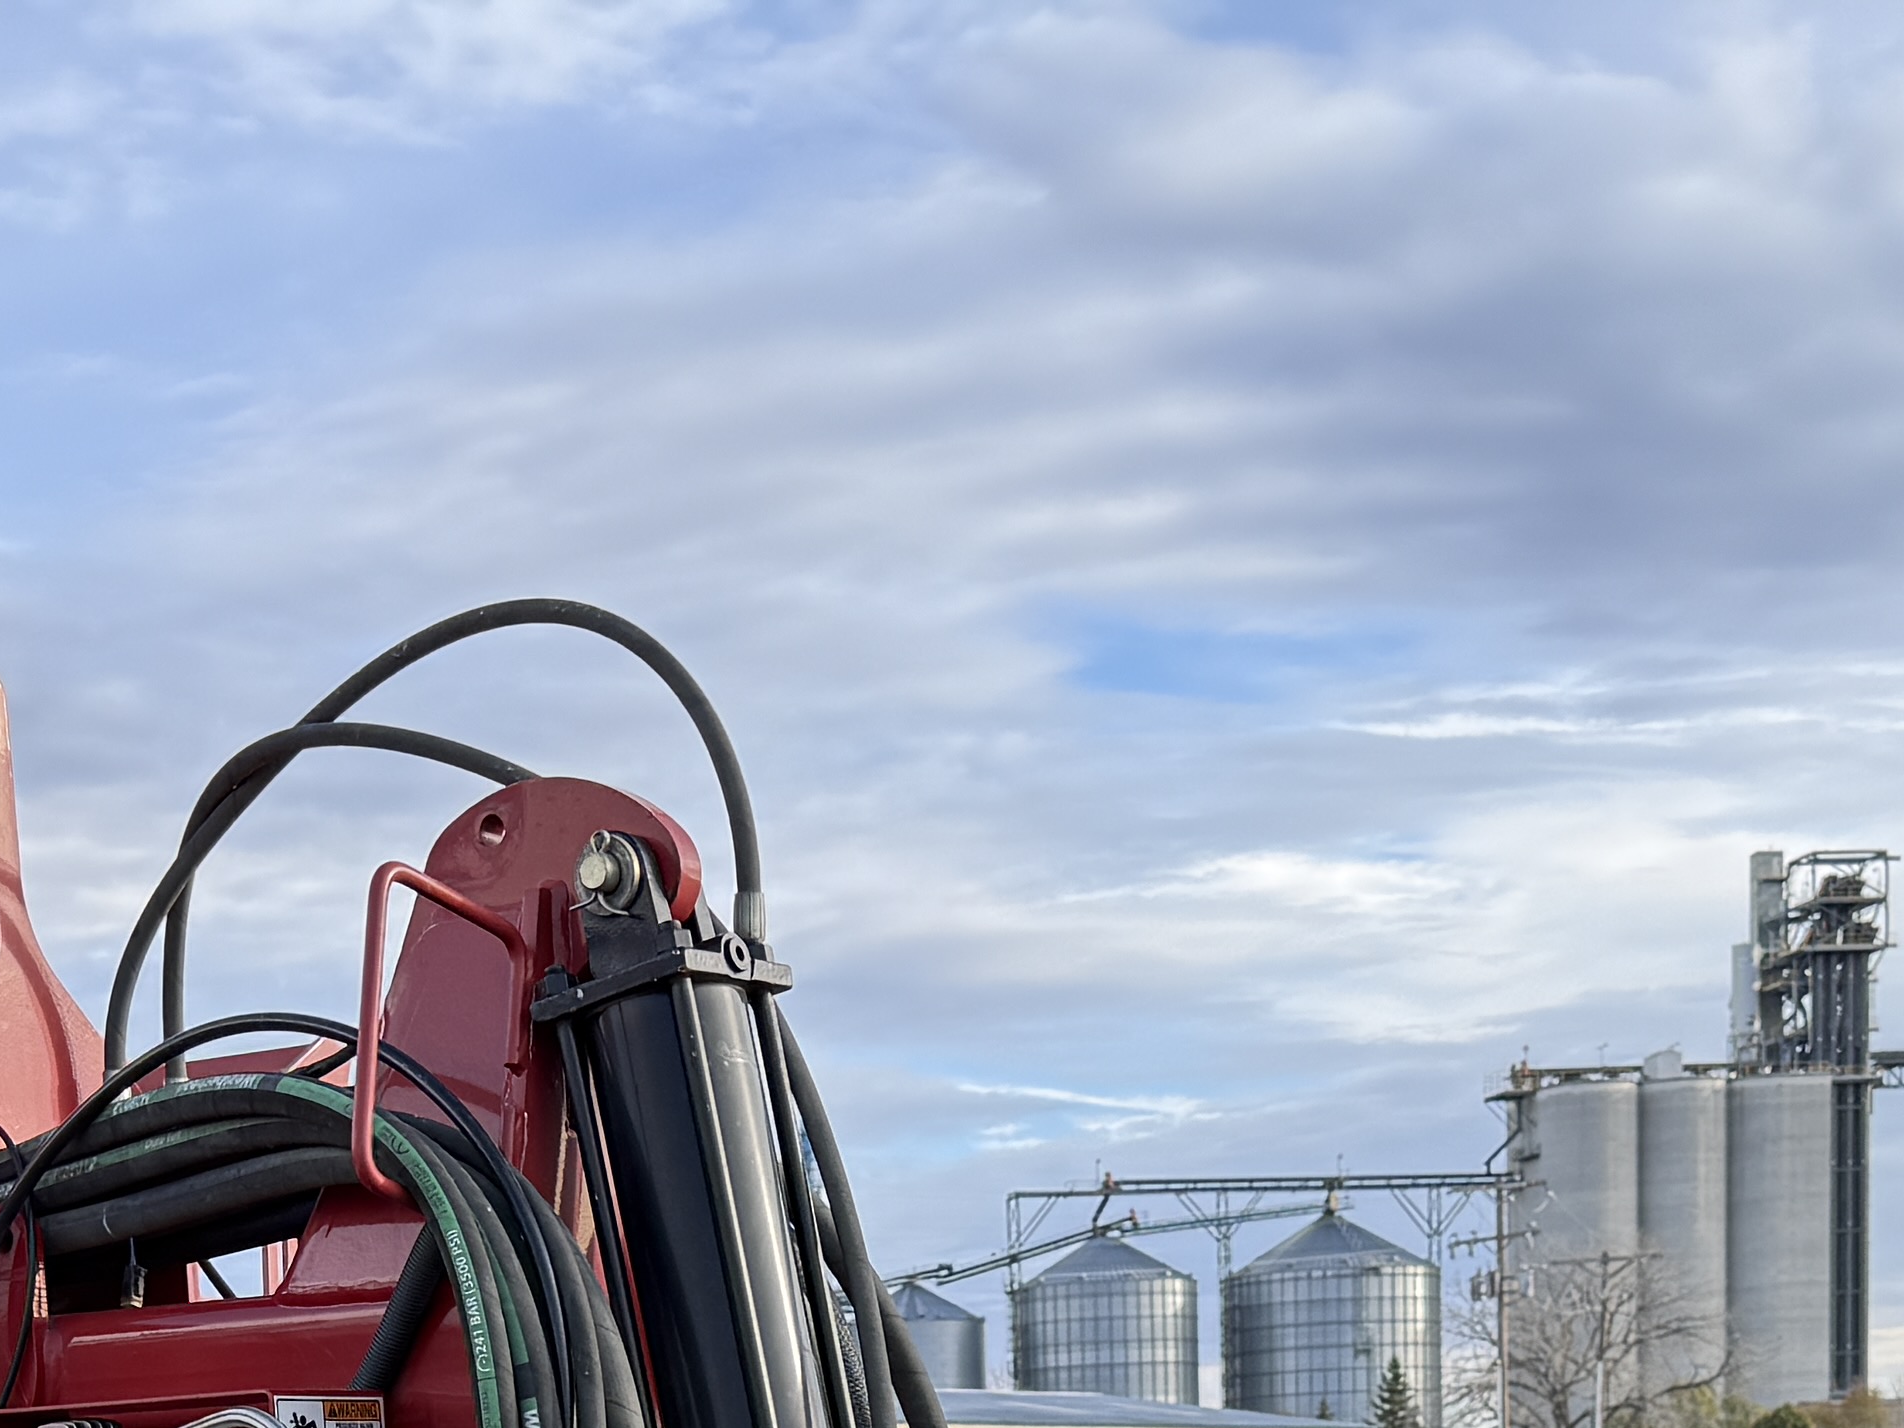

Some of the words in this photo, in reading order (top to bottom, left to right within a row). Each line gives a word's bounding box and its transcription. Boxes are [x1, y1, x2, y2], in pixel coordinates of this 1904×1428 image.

[466, 1296, 482, 1326] BAR
[473, 1329, 487, 1354] 241
[336, 1403, 378, 1418] WARNING
